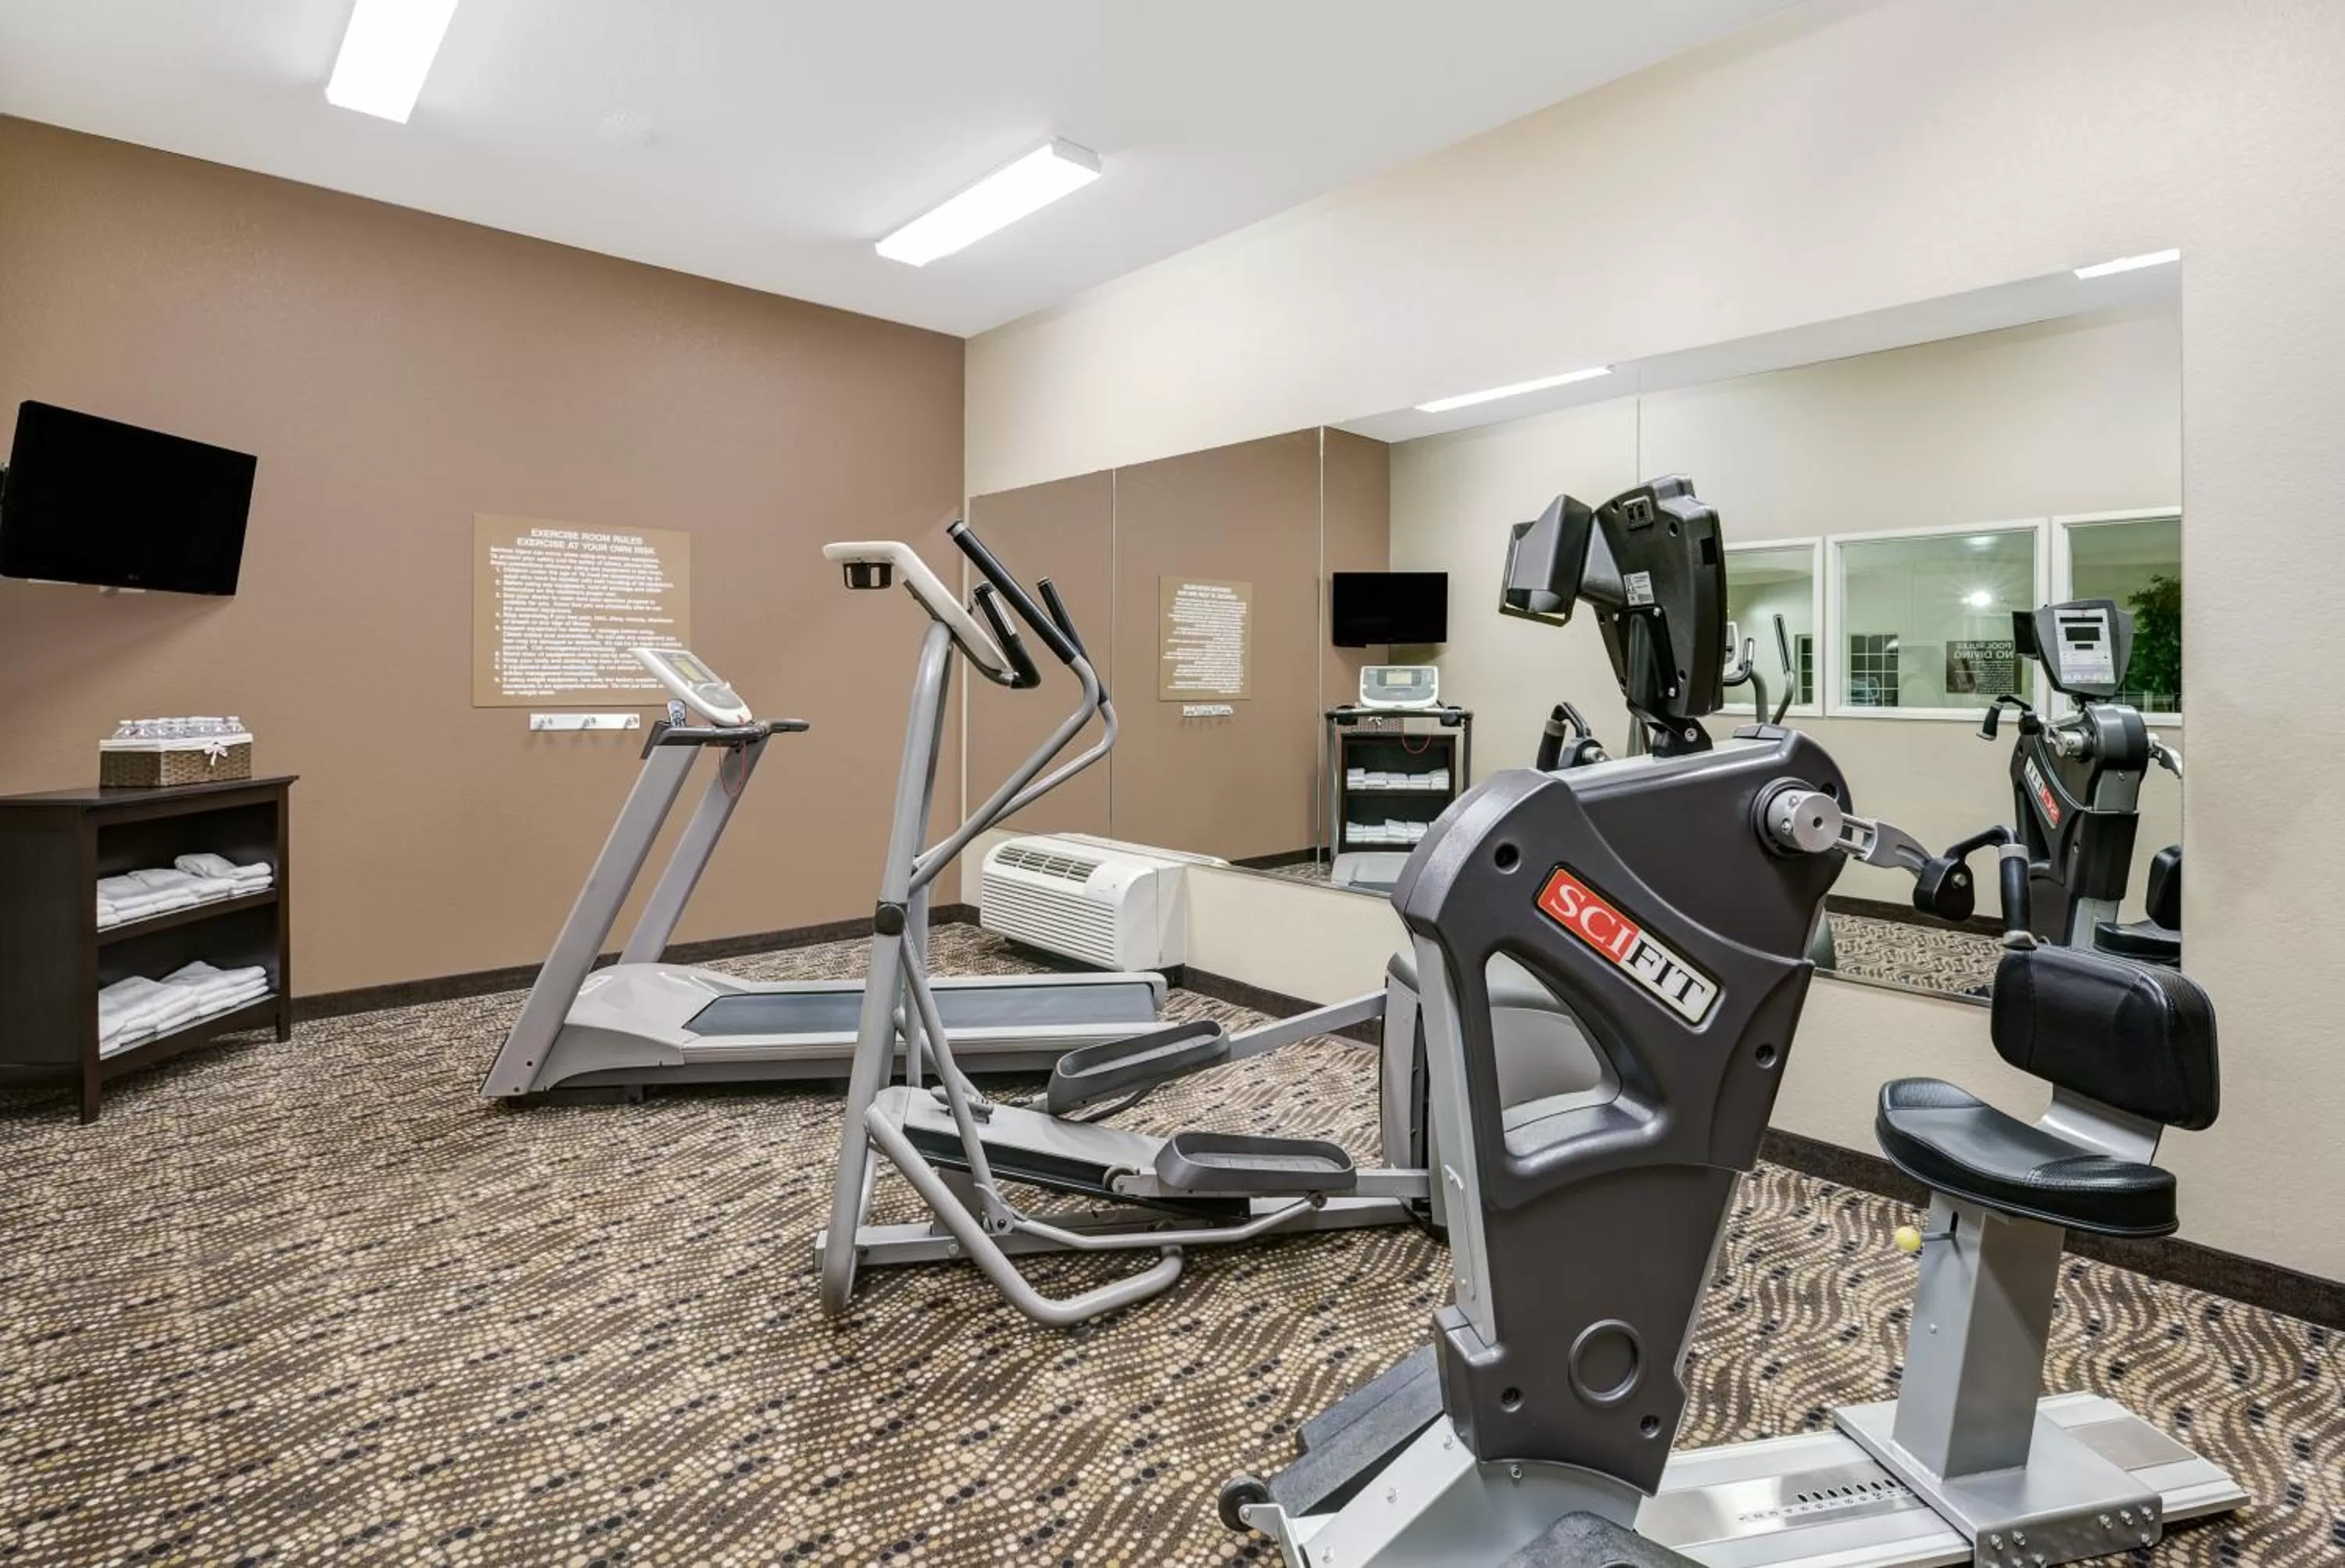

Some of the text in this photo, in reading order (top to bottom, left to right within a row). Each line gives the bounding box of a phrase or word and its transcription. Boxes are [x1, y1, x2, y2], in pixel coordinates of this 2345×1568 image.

[531, 528, 580, 541] EXERCISE
[582, 532, 610, 542] ROOM
[567, 541, 580, 550] AT
[582, 542, 608, 552] YOUR
[610, 544, 632, 554] OWN
